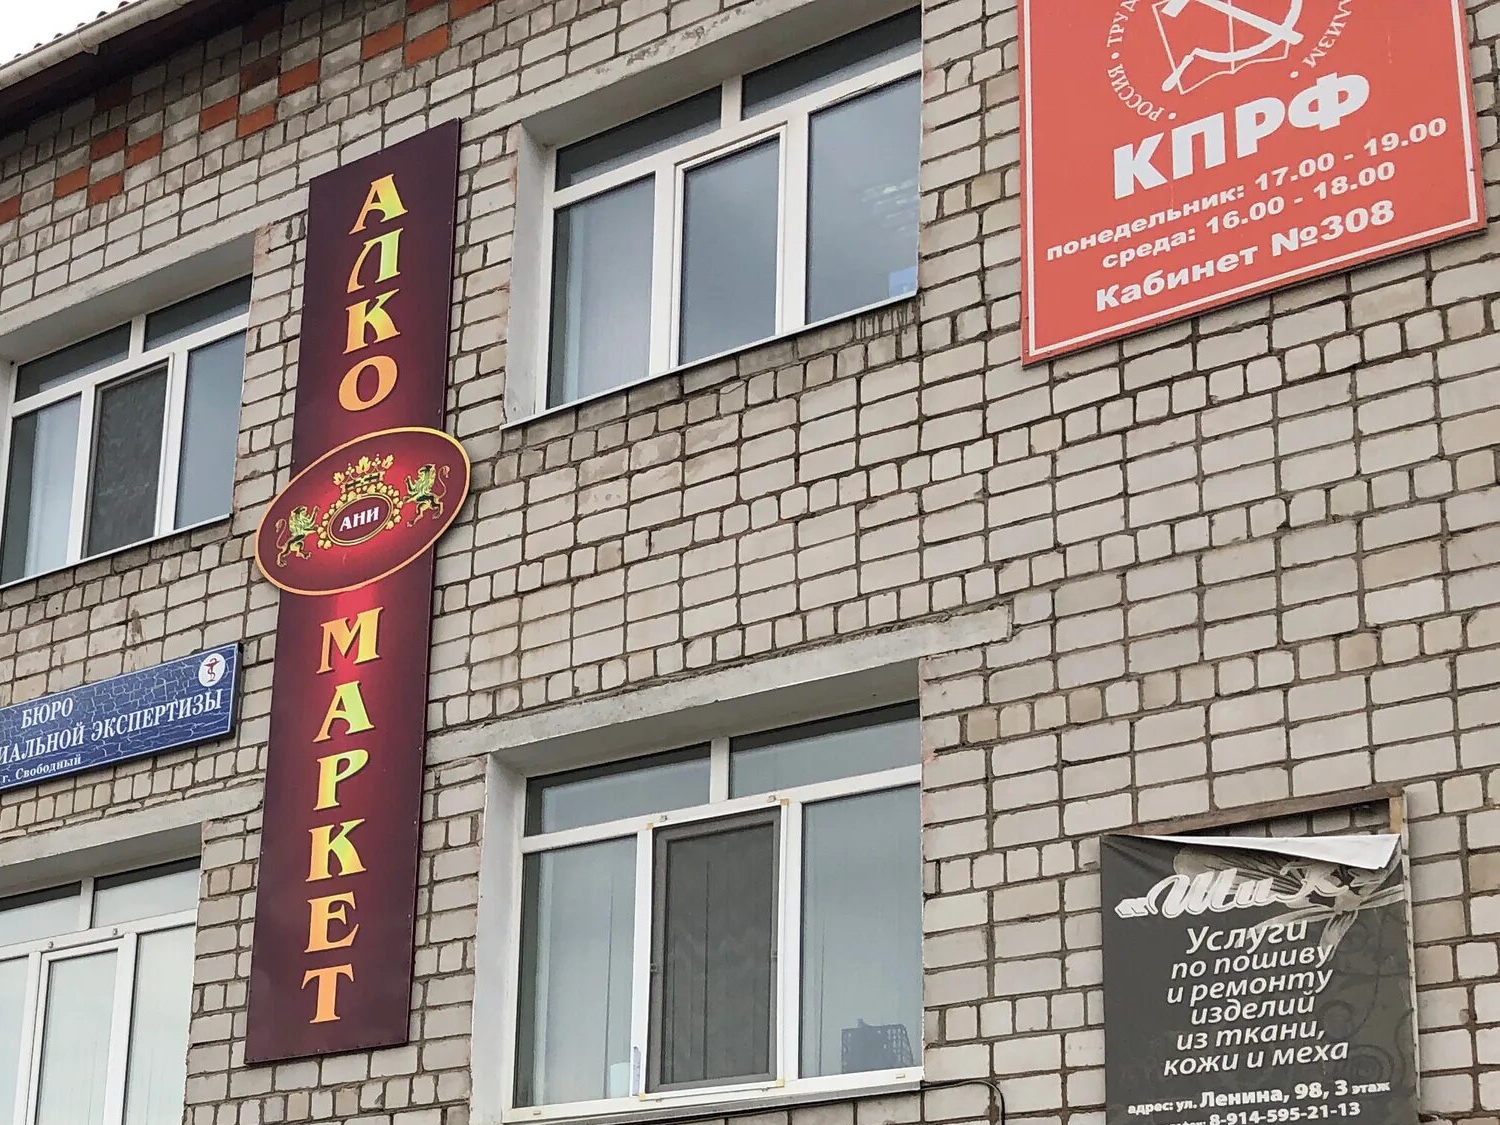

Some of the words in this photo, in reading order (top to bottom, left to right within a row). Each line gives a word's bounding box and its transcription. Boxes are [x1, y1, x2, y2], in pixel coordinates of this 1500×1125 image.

[1107, 64, 1165, 121] РОССИЯ
[1112, 72, 1370, 199] КПРФ
[1046, 185, 1245, 261] понедельник:
[1254, 152, 1335, 193] 17.00
[1364, 118, 1447, 158] 19.00
[1102, 227, 1196, 269] среда:
[1206, 197, 1285, 236] 16.00
[1313, 162, 1396, 202] 18.00
[1096, 246, 1259, 312] Кабинет
[1271, 200, 1395, 258] №308
[338, 174, 409, 412] АЛКО
[339, 506, 380, 533] АНИ
[21, 697, 74, 729] БЮРО
[90, 689, 223, 742] ЭКСПЕРТИЗЫ
[15, 754, 82, 780] Свободный
[301, 606, 384, 1024] МАРКЕТ
[1186, 919, 1308, 954] Услуги
[1171, 960, 1207, 980] по
[1214, 944, 1334, 975] пошиву
[1167, 986, 1184, 1004] и
[1190, 968, 1333, 1007] ремонту
[1191, 990, 1315, 1025] изделий
[1177, 1031, 1208, 1051] из
[1215, 1020, 1326, 1047] ткани,
[1163, 1053, 1239, 1076] кожи
[1246, 1051, 1264, 1068] и
[1271, 1041, 1349, 1066] меха
[1127, 1101, 1174, 1115] адрес:
[1176, 1100, 1197, 1113] ул.
[1200, 1088, 1289, 1109] Ленина,
[1294, 1082, 1329, 1100] 98,
[1334, 1079, 1348, 1097] 3
[1351, 1081, 1391, 1095] этаж
